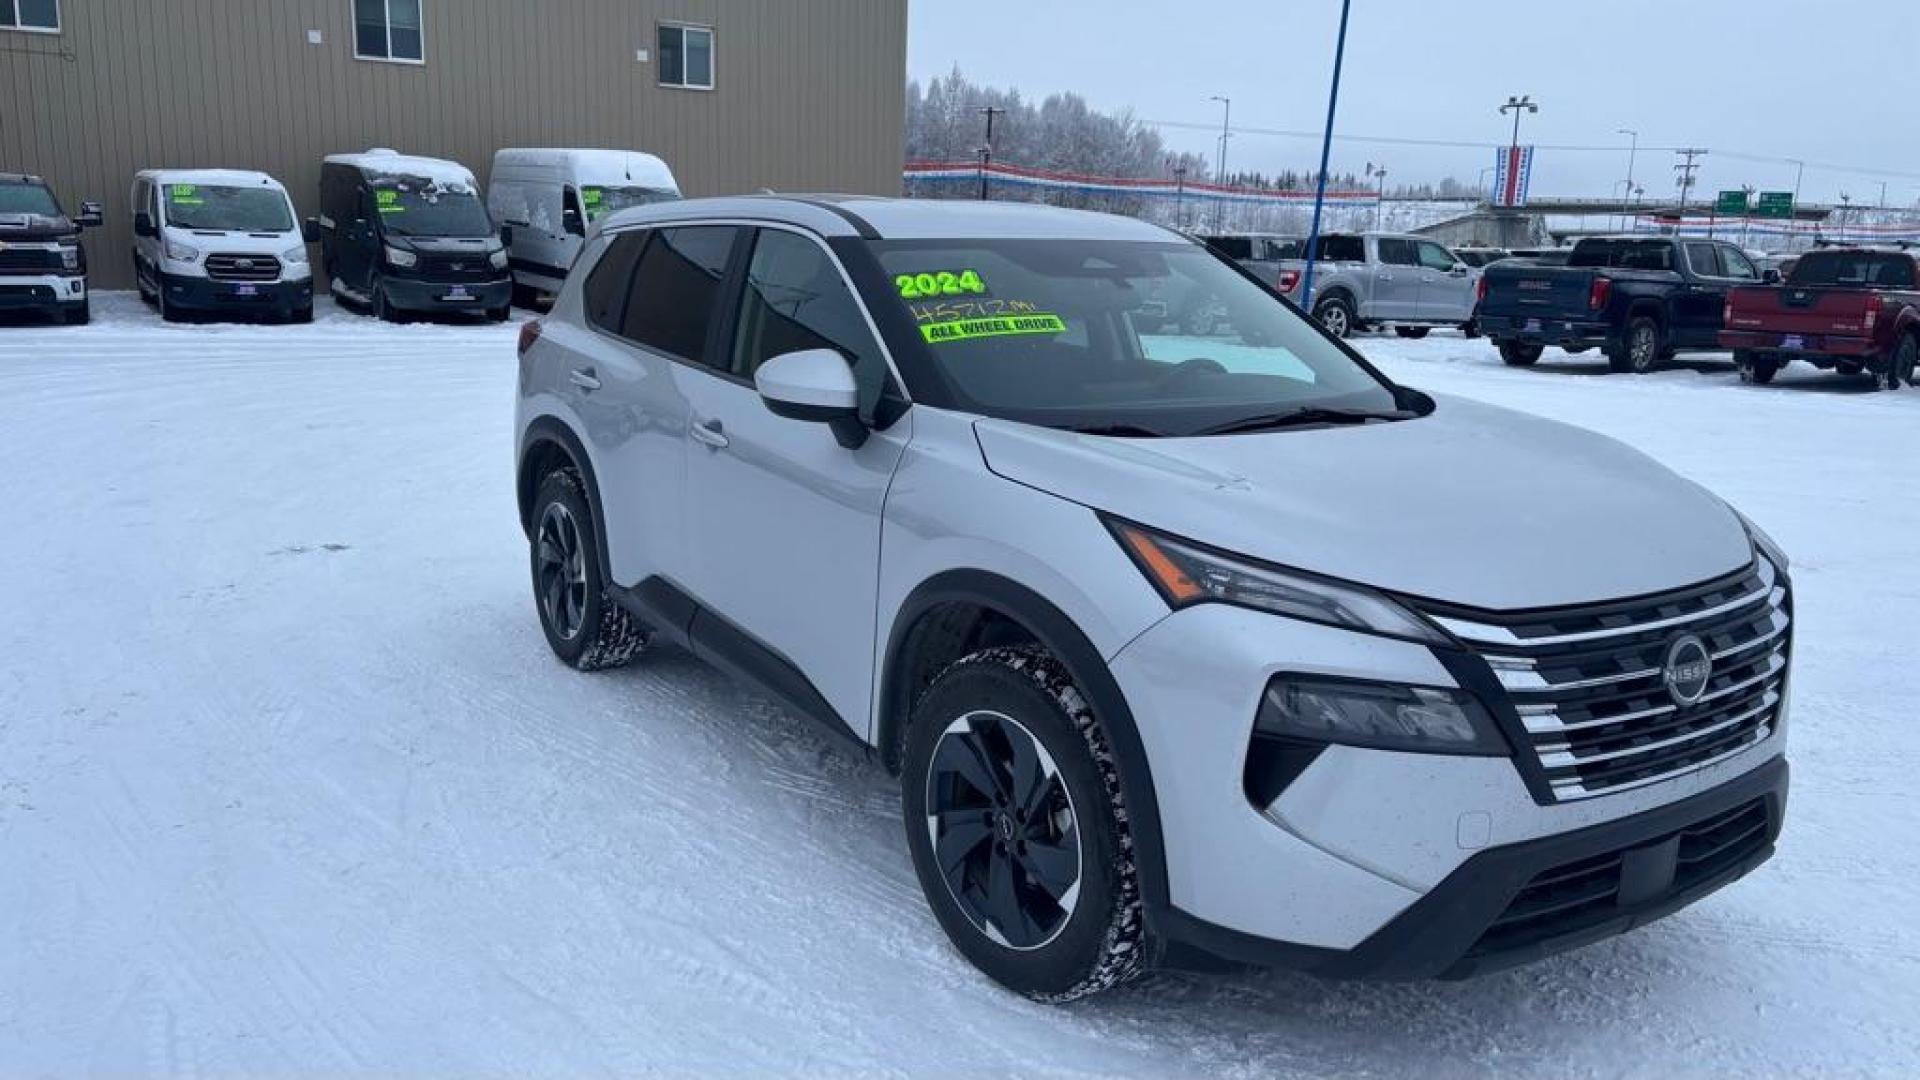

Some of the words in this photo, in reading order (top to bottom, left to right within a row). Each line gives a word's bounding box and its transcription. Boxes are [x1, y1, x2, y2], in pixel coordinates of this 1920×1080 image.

[896, 270, 985, 298] 2024
[930, 325, 959, 339] ALL
[959, 319, 1011, 334] WHEEL
[1013, 317, 1058, 331] DRIVE
